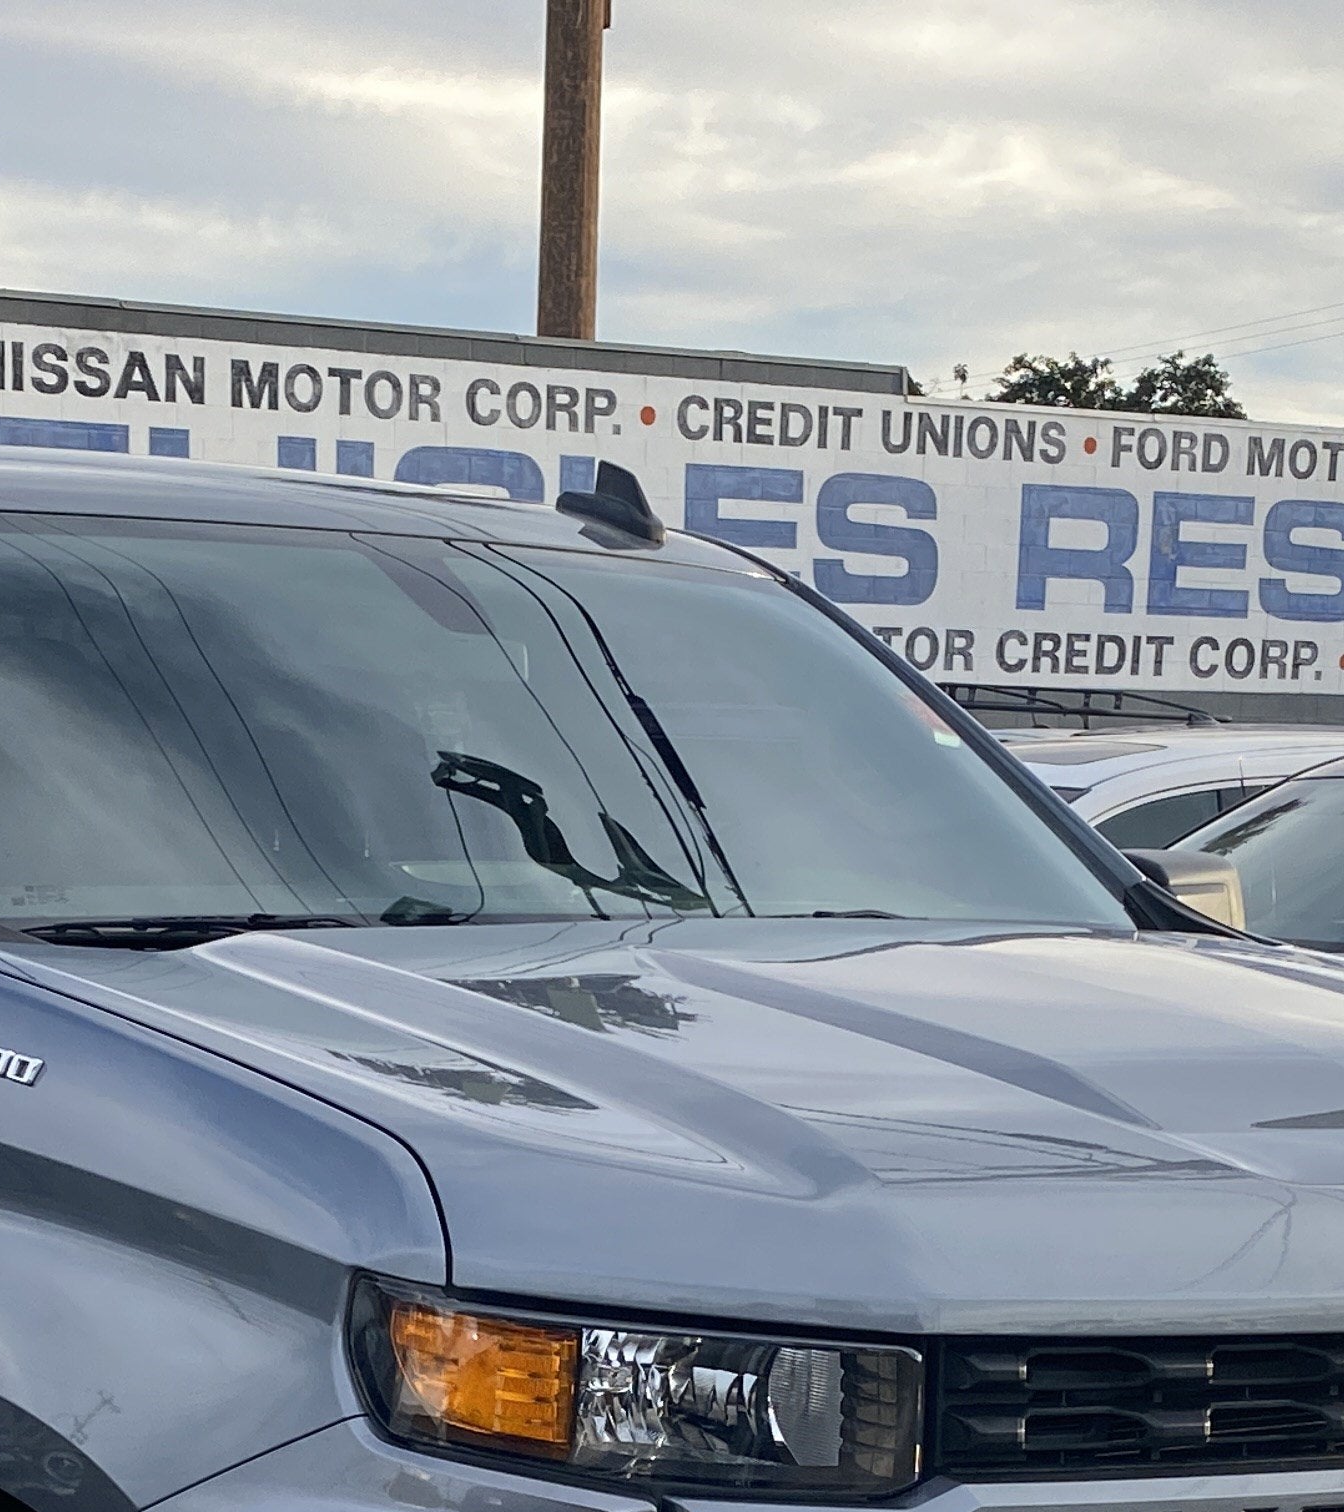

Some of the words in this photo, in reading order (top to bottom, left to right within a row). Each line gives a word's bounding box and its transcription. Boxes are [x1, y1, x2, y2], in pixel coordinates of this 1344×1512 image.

[231, 359, 442, 422] MOTOR
[464, 378, 622, 436] CORP.
[676, 394, 863, 452] CREDIT
[881, 409, 1067, 465] UNIONS
[1111, 426, 1230, 474] FORD
[995, 629, 1174, 678] CREDIT
[1189, 636, 1323, 682] CORP.
